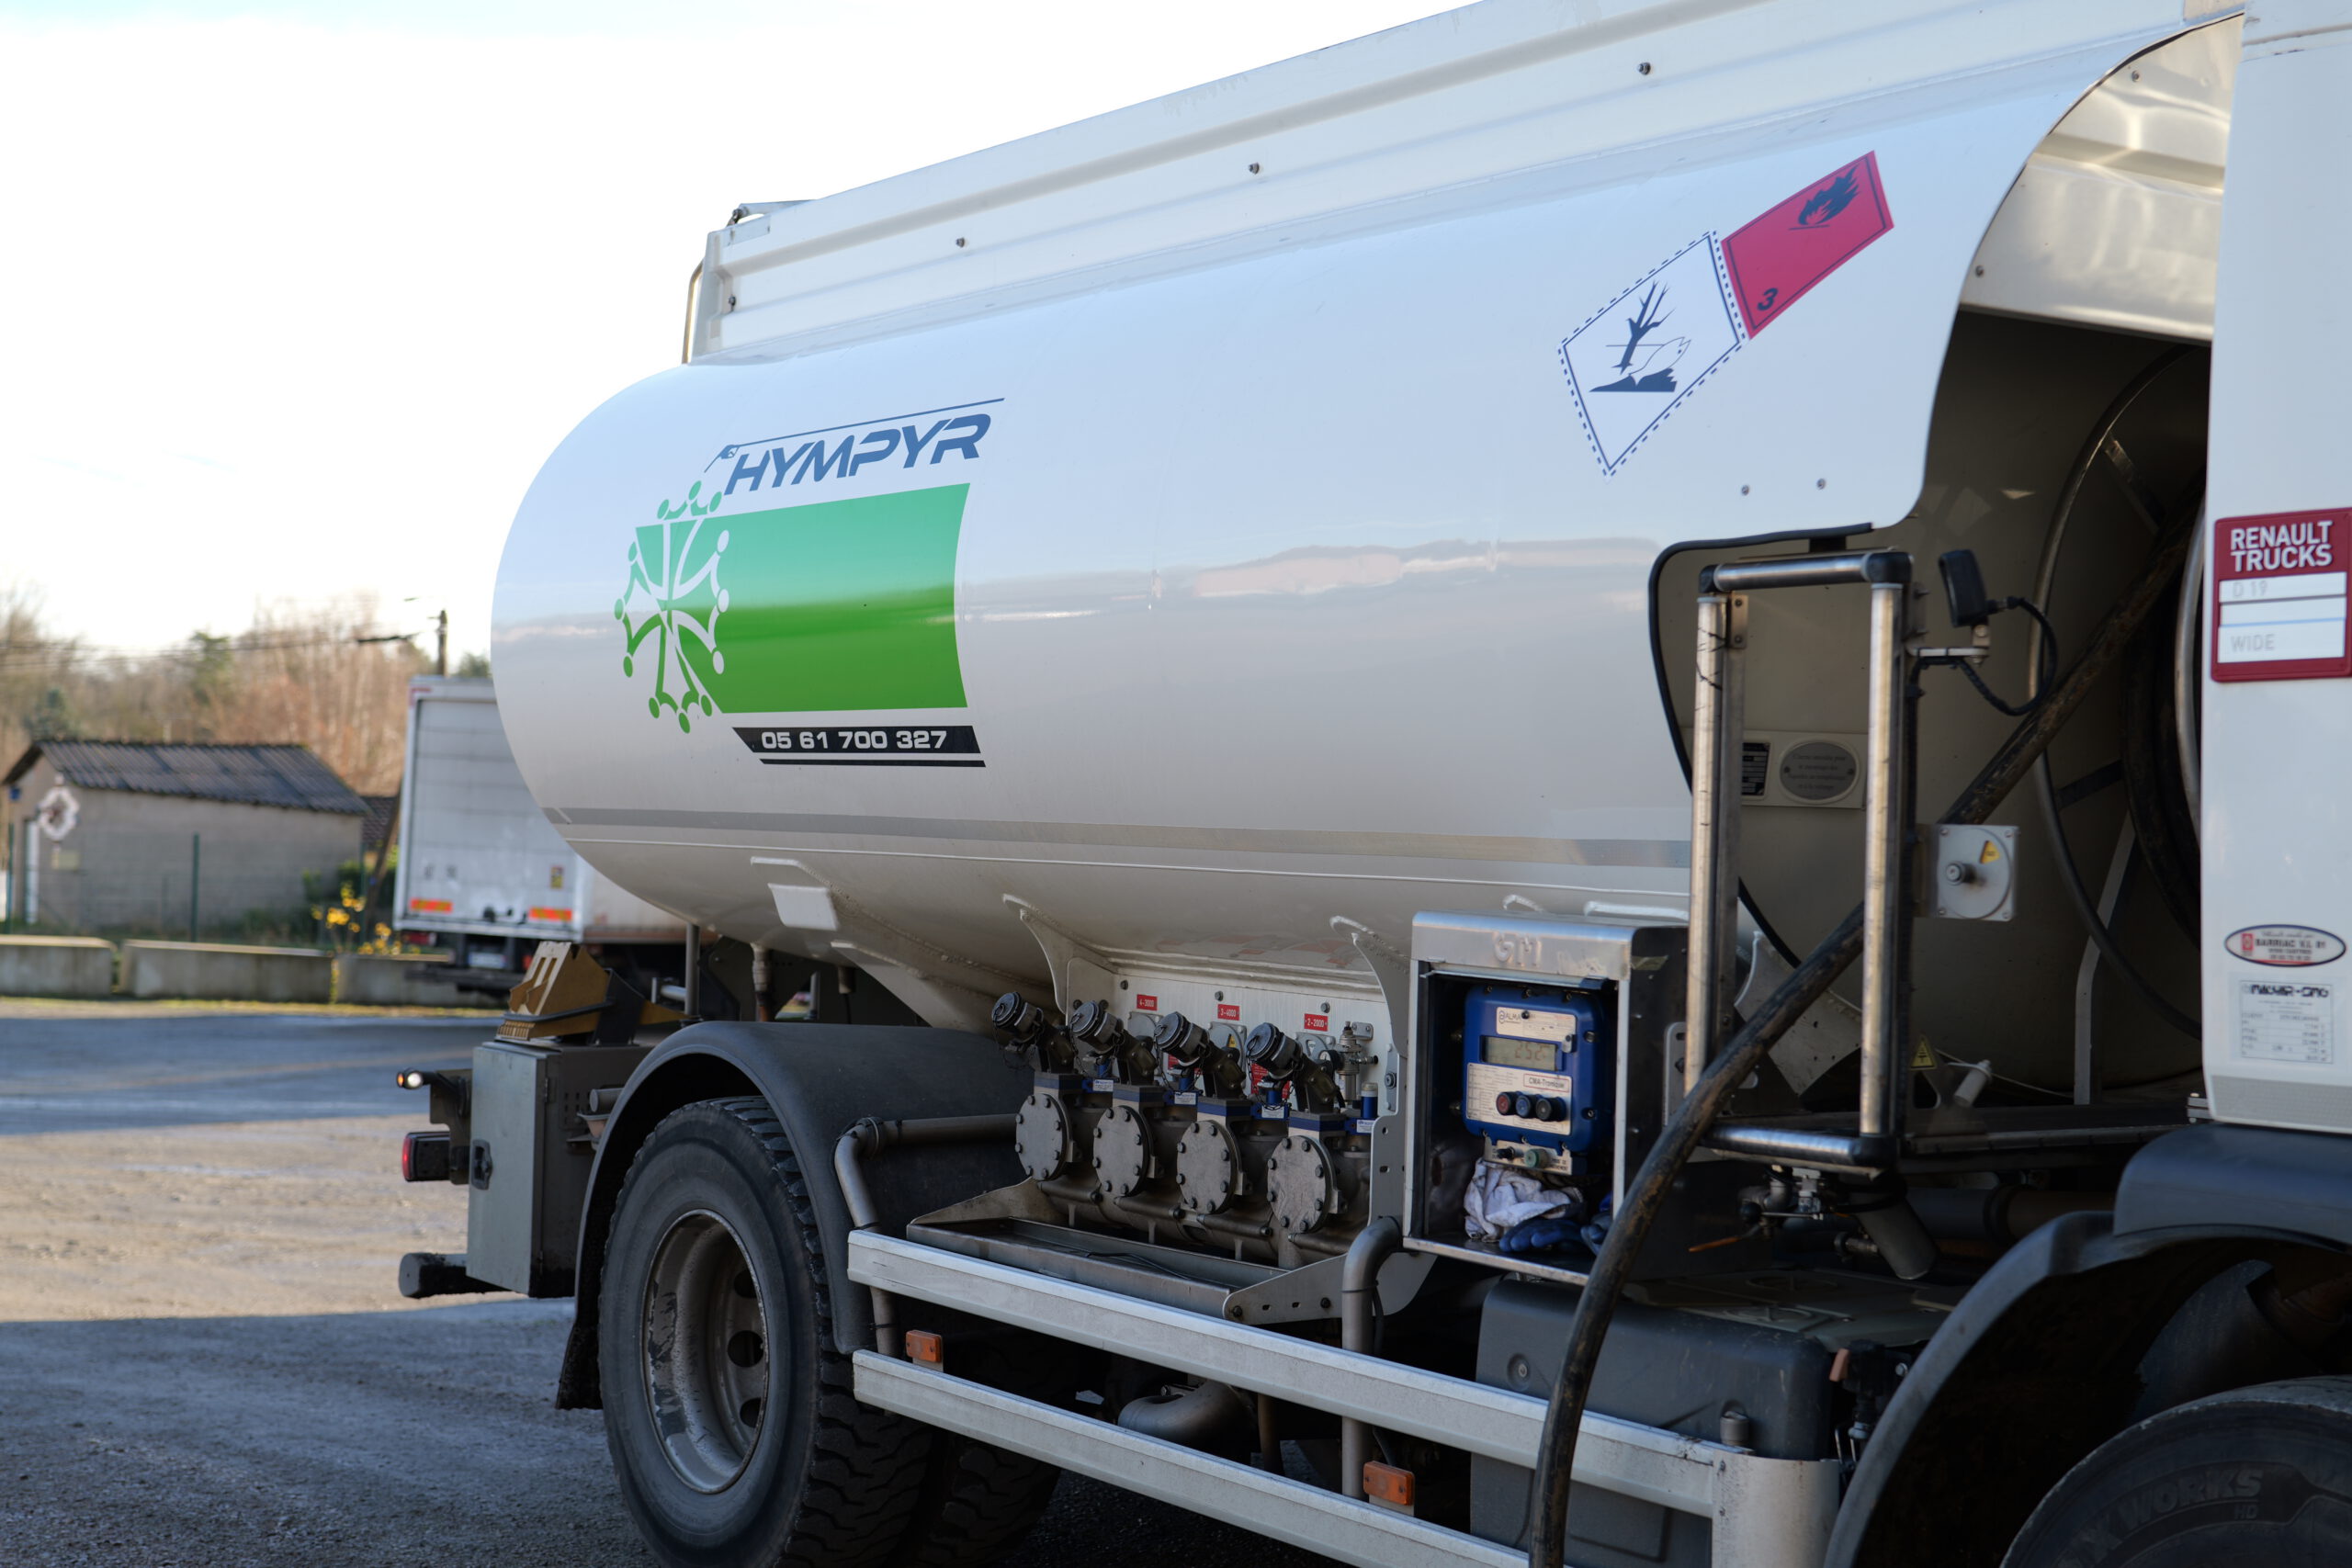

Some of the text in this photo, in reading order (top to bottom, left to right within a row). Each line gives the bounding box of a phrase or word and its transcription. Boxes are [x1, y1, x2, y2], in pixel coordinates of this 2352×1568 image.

[1758, 288, 1779, 310] 3
[723, 413, 991, 496] HYMPYR
[2230, 520, 2334, 550] RENAULT
[2230, 544, 2333, 572] TRUCKS
[2231, 633, 2275, 652] WIDE
[761, 730, 947, 749] 05 61 700 327
[2116, 1469, 2264, 1530] WORKS
